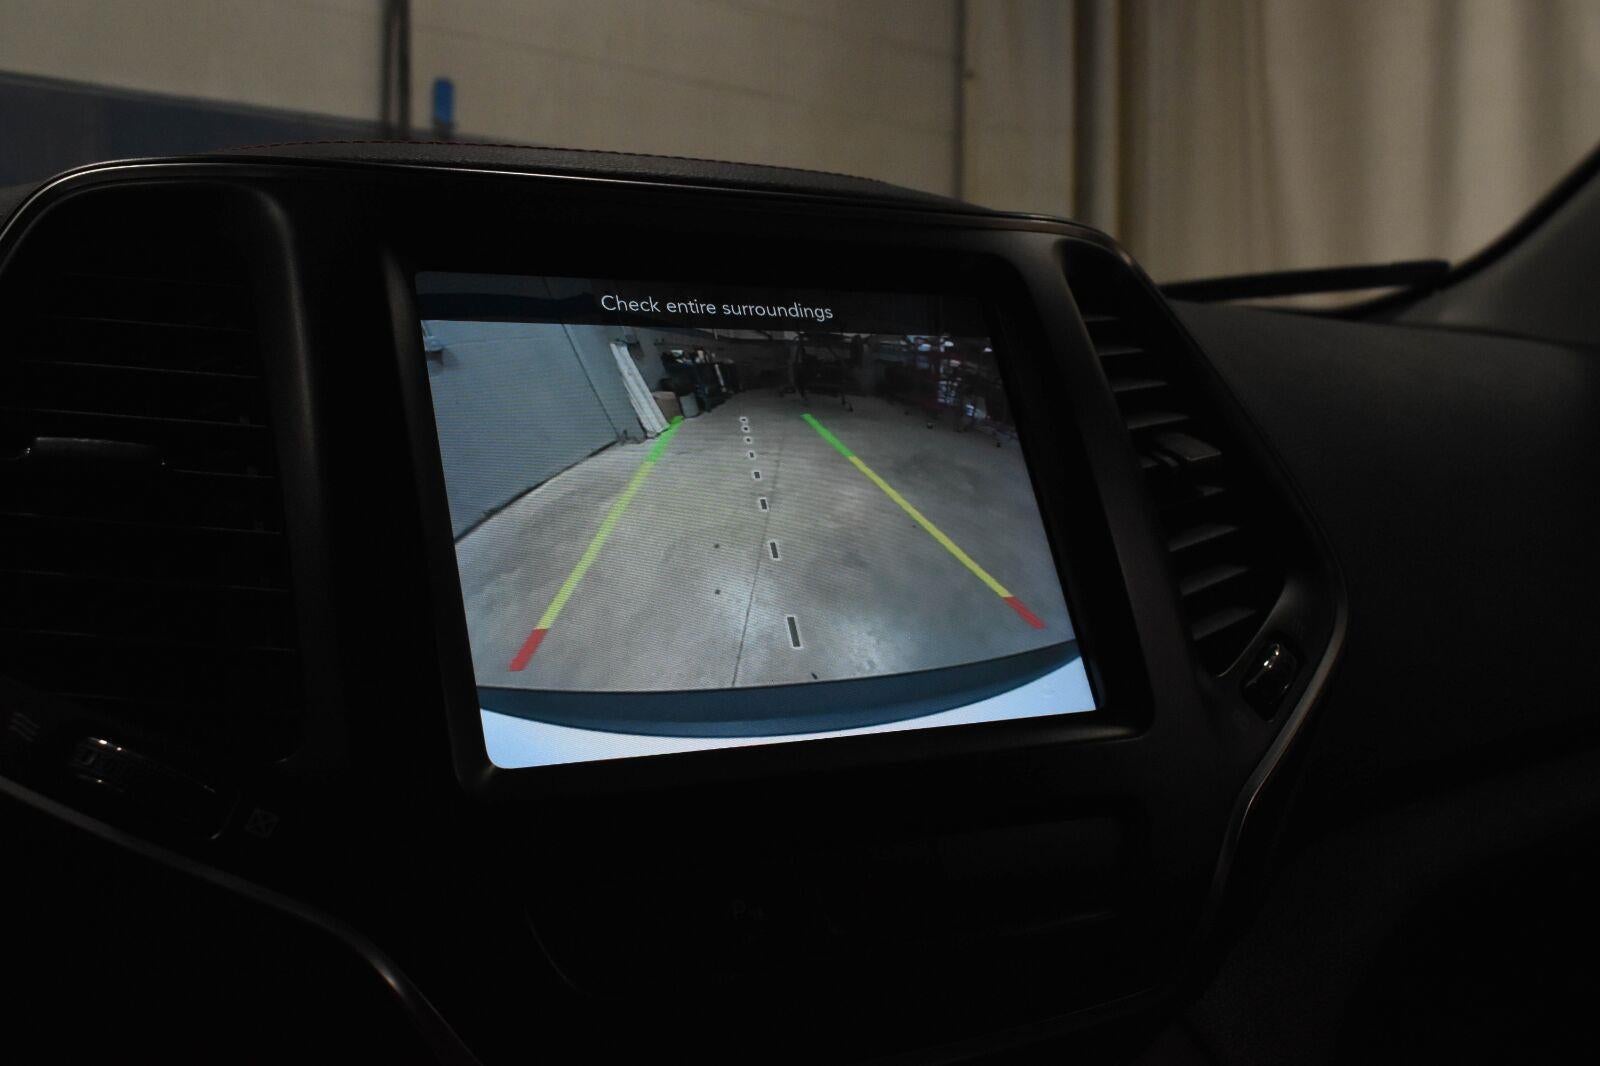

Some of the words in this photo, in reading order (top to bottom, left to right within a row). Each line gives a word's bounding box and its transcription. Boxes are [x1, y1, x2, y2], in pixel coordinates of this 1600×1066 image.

[600, 294, 662, 313] Check
[666, 298, 717, 315] entire
[722, 302, 834, 322] surroundings
